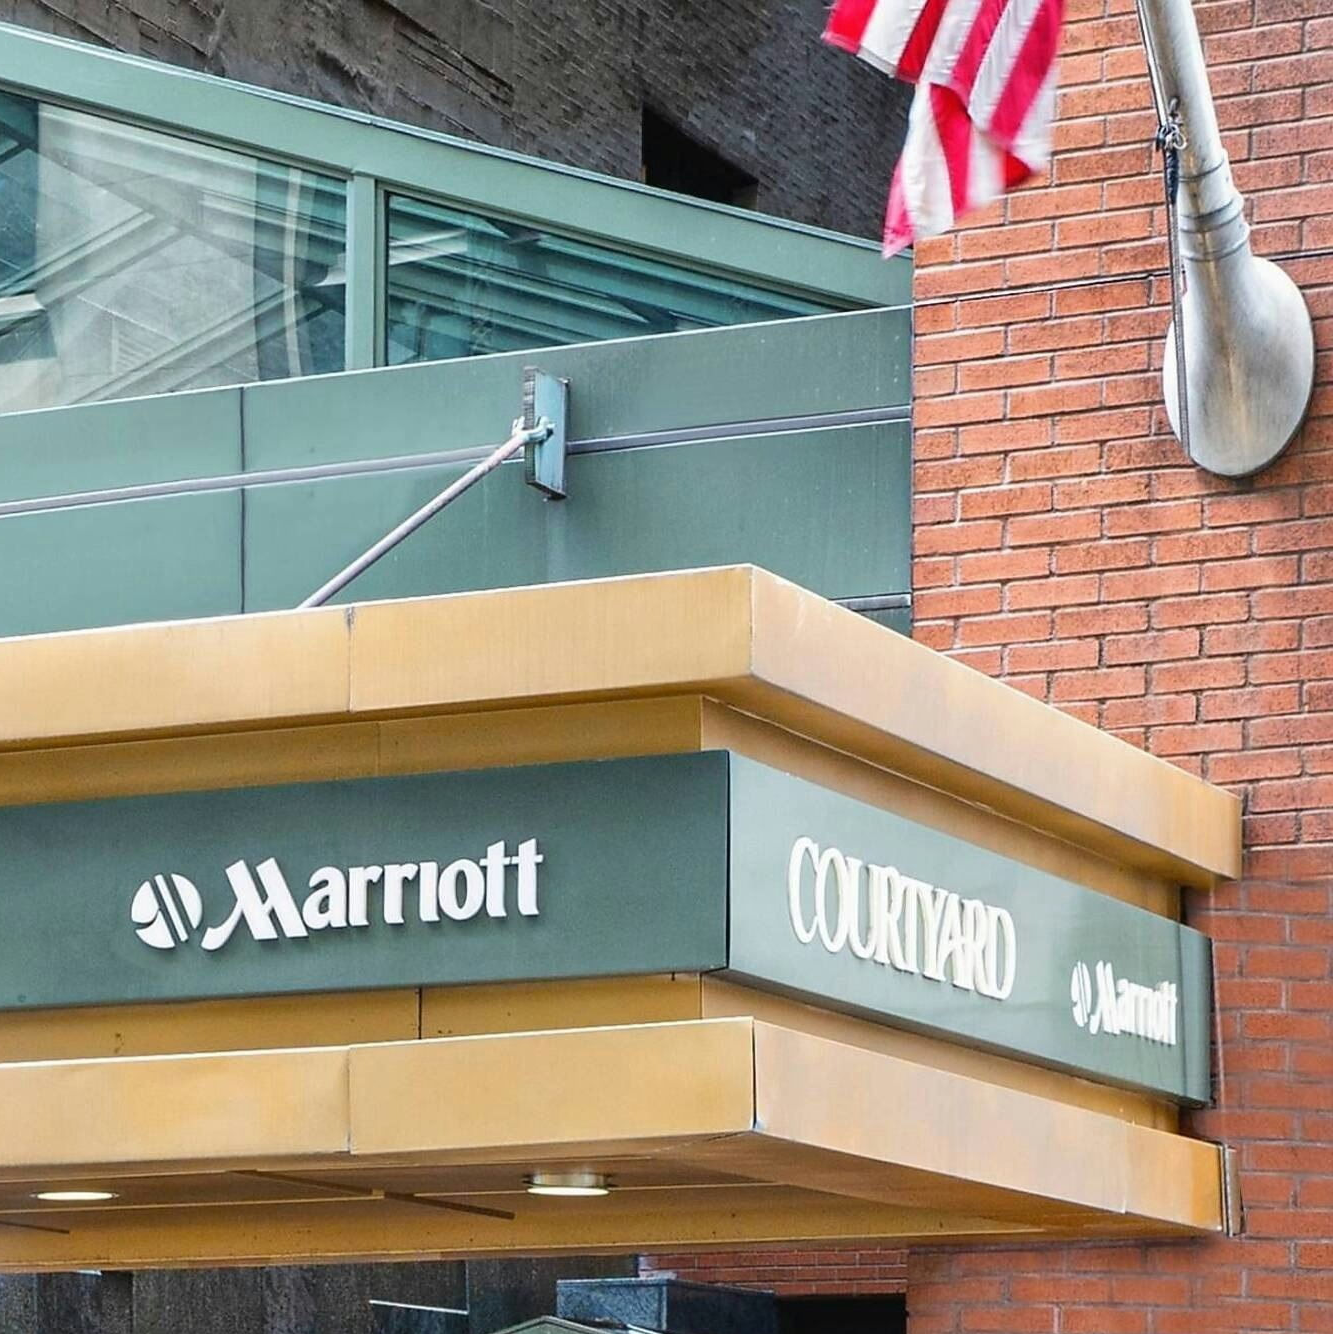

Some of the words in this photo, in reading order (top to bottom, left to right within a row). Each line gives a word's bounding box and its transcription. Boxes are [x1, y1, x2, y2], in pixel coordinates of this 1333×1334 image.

[199, 837, 544, 952] Marriott
[787, 836, 1017, 1001] COURTYARD
[1090, 959, 1178, 1046] Marriott
